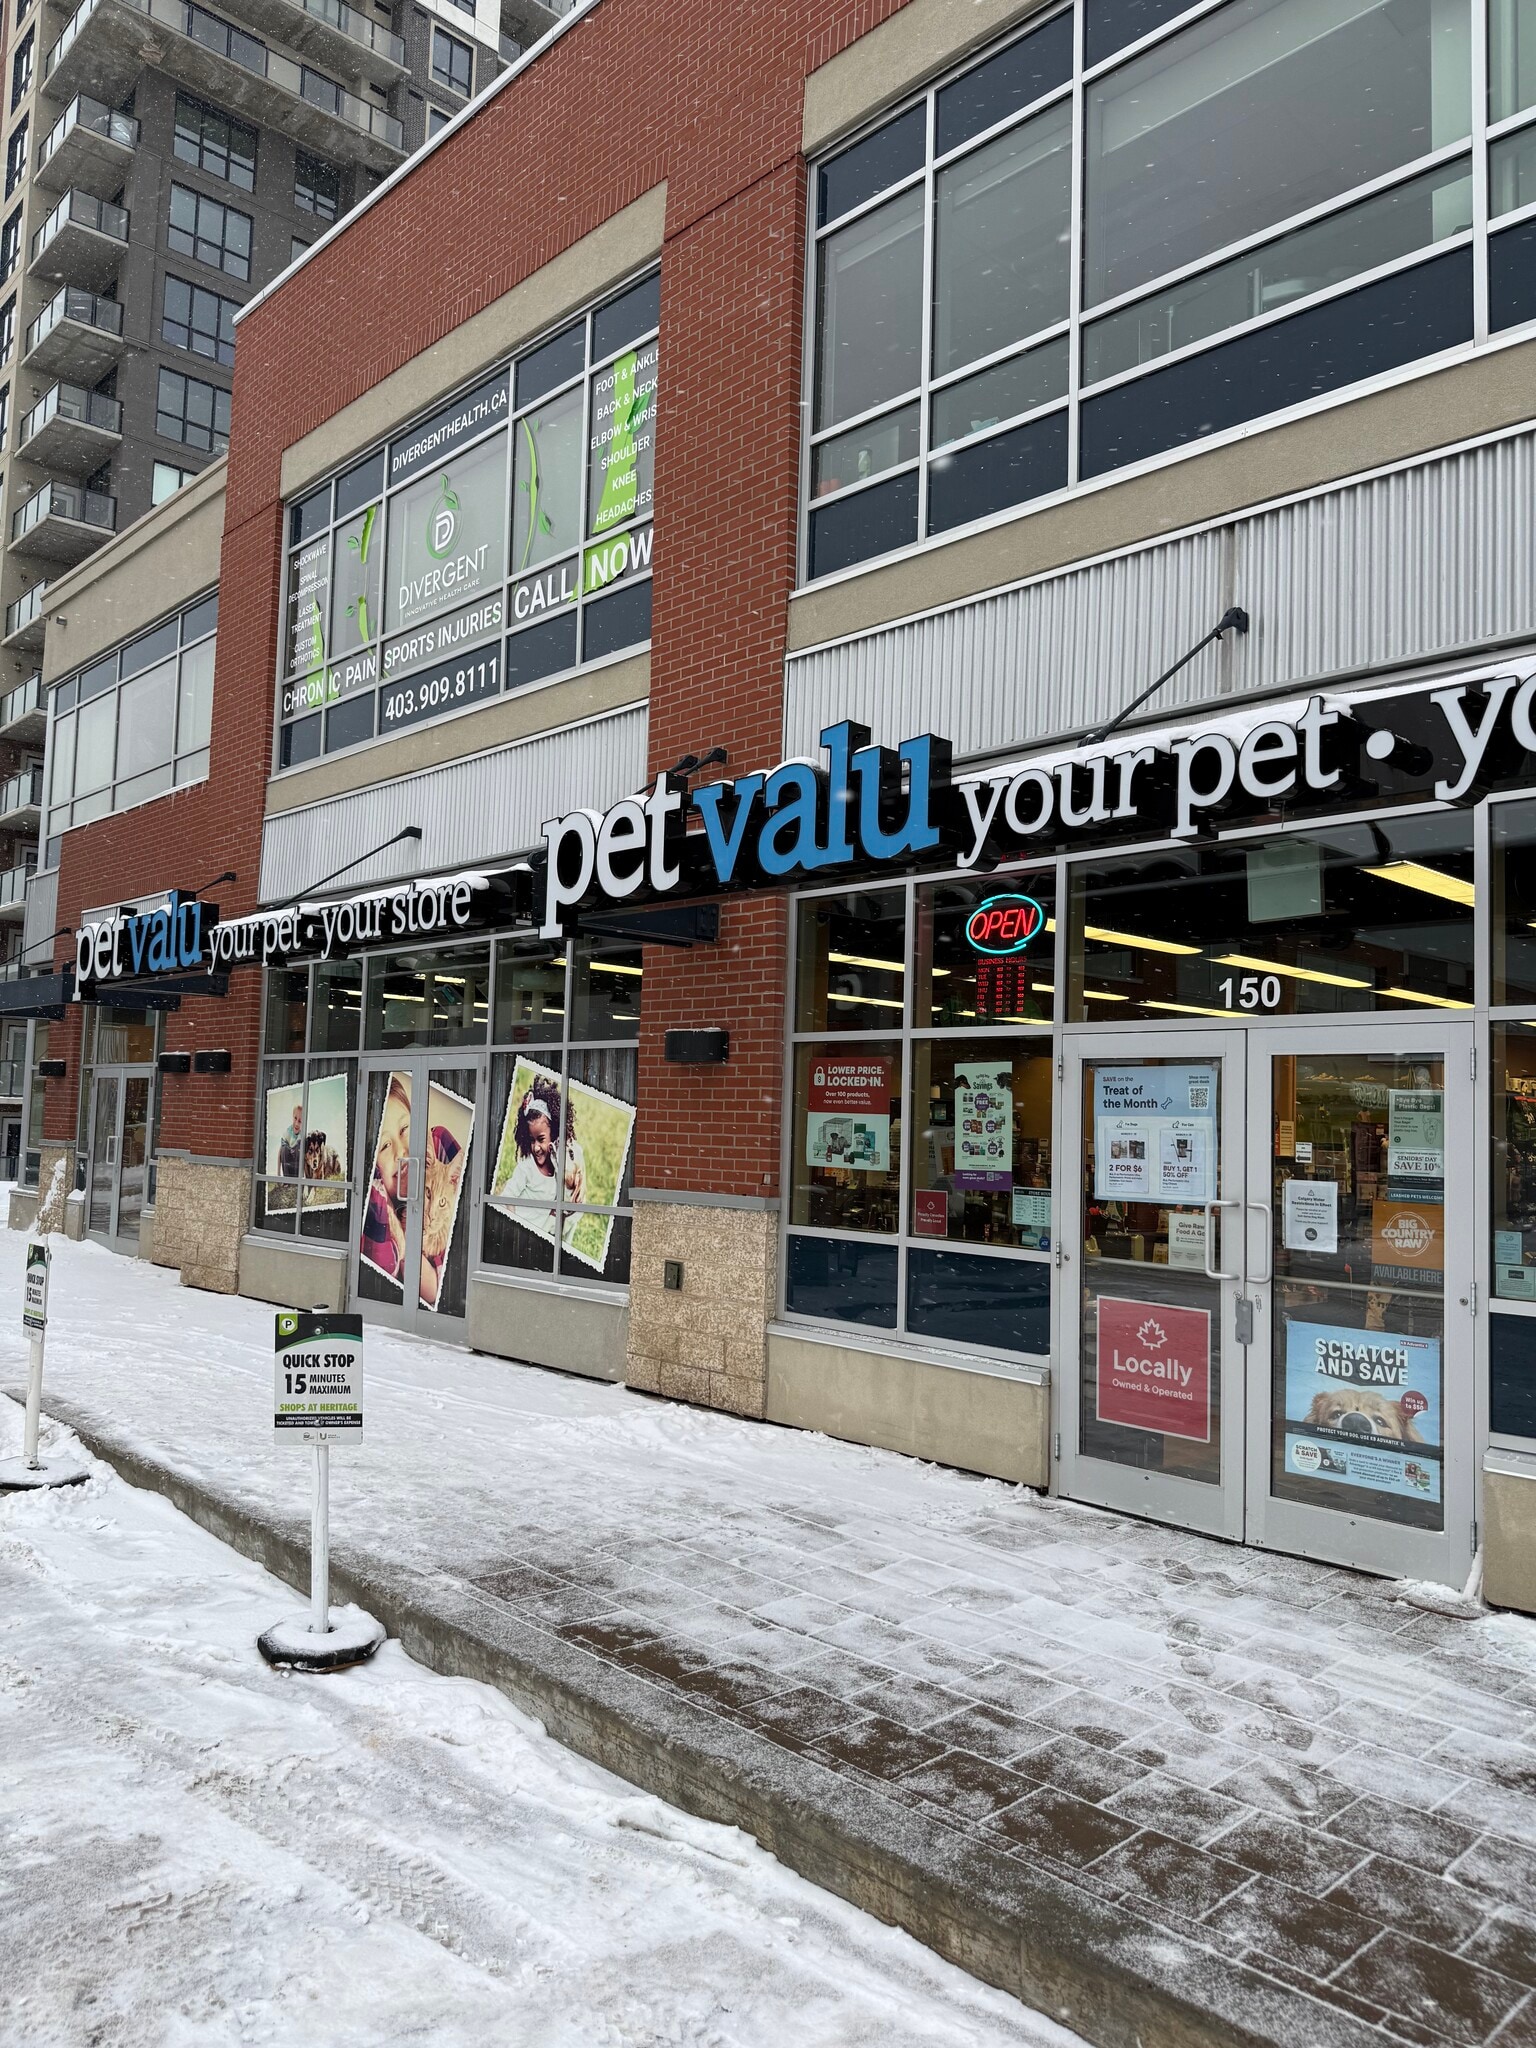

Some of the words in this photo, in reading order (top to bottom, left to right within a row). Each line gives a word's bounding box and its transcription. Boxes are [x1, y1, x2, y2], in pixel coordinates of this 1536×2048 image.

[596, 372, 619, 396] FOOT
[621, 368, 628, 380] &
[630, 348, 659, 376] ANKLE
[597, 396, 622, 421] BACK
[624, 392, 631, 406] &
[633, 376, 658, 399] NECK
[392, 388, 508, 473] DIVERGENTHEALTH.CA
[591, 423, 623, 450] ELBOW
[624, 419, 631, 432] &
[633, 404, 658, 427] WRIS
[601, 436, 650, 470] SHOULDER
[612, 469, 637, 492] KNEE
[596, 488, 652, 526] HEADACHES
[294, 544, 327, 570] SHOCKWAVE
[300, 570, 318, 586] SPINAL
[399, 544, 488, 610] DIVERGENT
[515, 568, 573, 619] CALL
[591, 528, 654, 588] NOW
[288, 577, 329, 604] DECOMPRESSION
[404, 598, 437, 618] INNOVATIVE
[439, 587, 462, 602] HEALTH
[463, 578, 480, 590] CARE
[299, 602, 315, 618] LASER
[291, 612, 323, 635] TREATMENT
[294, 635, 317, 653] CUSTOM
[283, 672, 341, 712] CHRONIC
[345, 656, 376, 688] PAIN
[384, 632, 435, 669] SPORTS
[438, 602, 502, 648] INJURIES
[290, 648, 320, 669] ORTHOTICS
[386, 657, 497, 720] 403.909.8111
[539, 771, 682, 940] pet
[693, 720, 940, 883] valu
[956, 746, 1157, 868] your
[1170, 696, 1342, 837] pet
[970, 908, 1036, 940] OPEN
[72, 907, 125, 1002] pet
[128, 889, 202, 974] valu
[208, 922, 259, 975] your
[262, 905, 301, 967] pet
[321, 895, 388, 960] your
[392, 881, 472, 934] store
[978, 958, 1004, 966] BUSINESS
[1219, 976, 1281, 1009] 150
[828, 1066, 856, 1075] LOWER
[858, 1066, 885, 1075] PRICE.
[827, 1076, 867, 1087] LOCKED
[870, 1077, 884, 1087] IN.
[973, 1082, 993, 1093] Savings
[1103, 1086, 1129, 1095] Treat
[1132, 1085, 1144, 1095] of
[1103, 1099, 1121, 1108] the
[1124, 1099, 1158, 1108] Month
[1134, 1165, 1143, 1173] $6
[1394, 1162, 1422, 1171] SAVE
[1424, 1163, 1441, 1171] 10%
[1382, 1229, 1436, 1239] COUNTRY
[1399, 1220, 1418, 1229] BIG
[1395, 1239, 1422, 1249] RAW
[27, 1273, 36, 1285] QUICK
[36, 1275, 44, 1286] STOP
[1374, 1266, 1419, 1281] AVAILABLE
[1420, 1270, 1443, 1284] HERE
[27, 1287, 32, 1302] 15
[286, 1321, 292, 1329] P
[283, 1354, 321, 1369] QUICK
[324, 1354, 355, 1368] STOP
[1315, 1338, 1409, 1367] SCRATCH
[1114, 1350, 1193, 1387] Locally
[1314, 1356, 1354, 1377] AND
[1359, 1364, 1409, 1386] SAVE
[285, 1374, 307, 1395] 15
[310, 1374, 346, 1383] MINUTES
[310, 1385, 351, 1395] MAXIMUM
[1112, 1378, 1141, 1392] Owned
[1144, 1384, 1150, 1393] &
[1152, 1386, 1193, 1401] Operated
[280, 1403, 306, 1412] SHOPS
[320, 1403, 358, 1411] HERITAGE
[1296, 1444, 1318, 1453] SCRATCH
[1301, 1450, 1318, 1459] SAVE
[1351, 1452, 1379, 1461] EVERYONE'S
